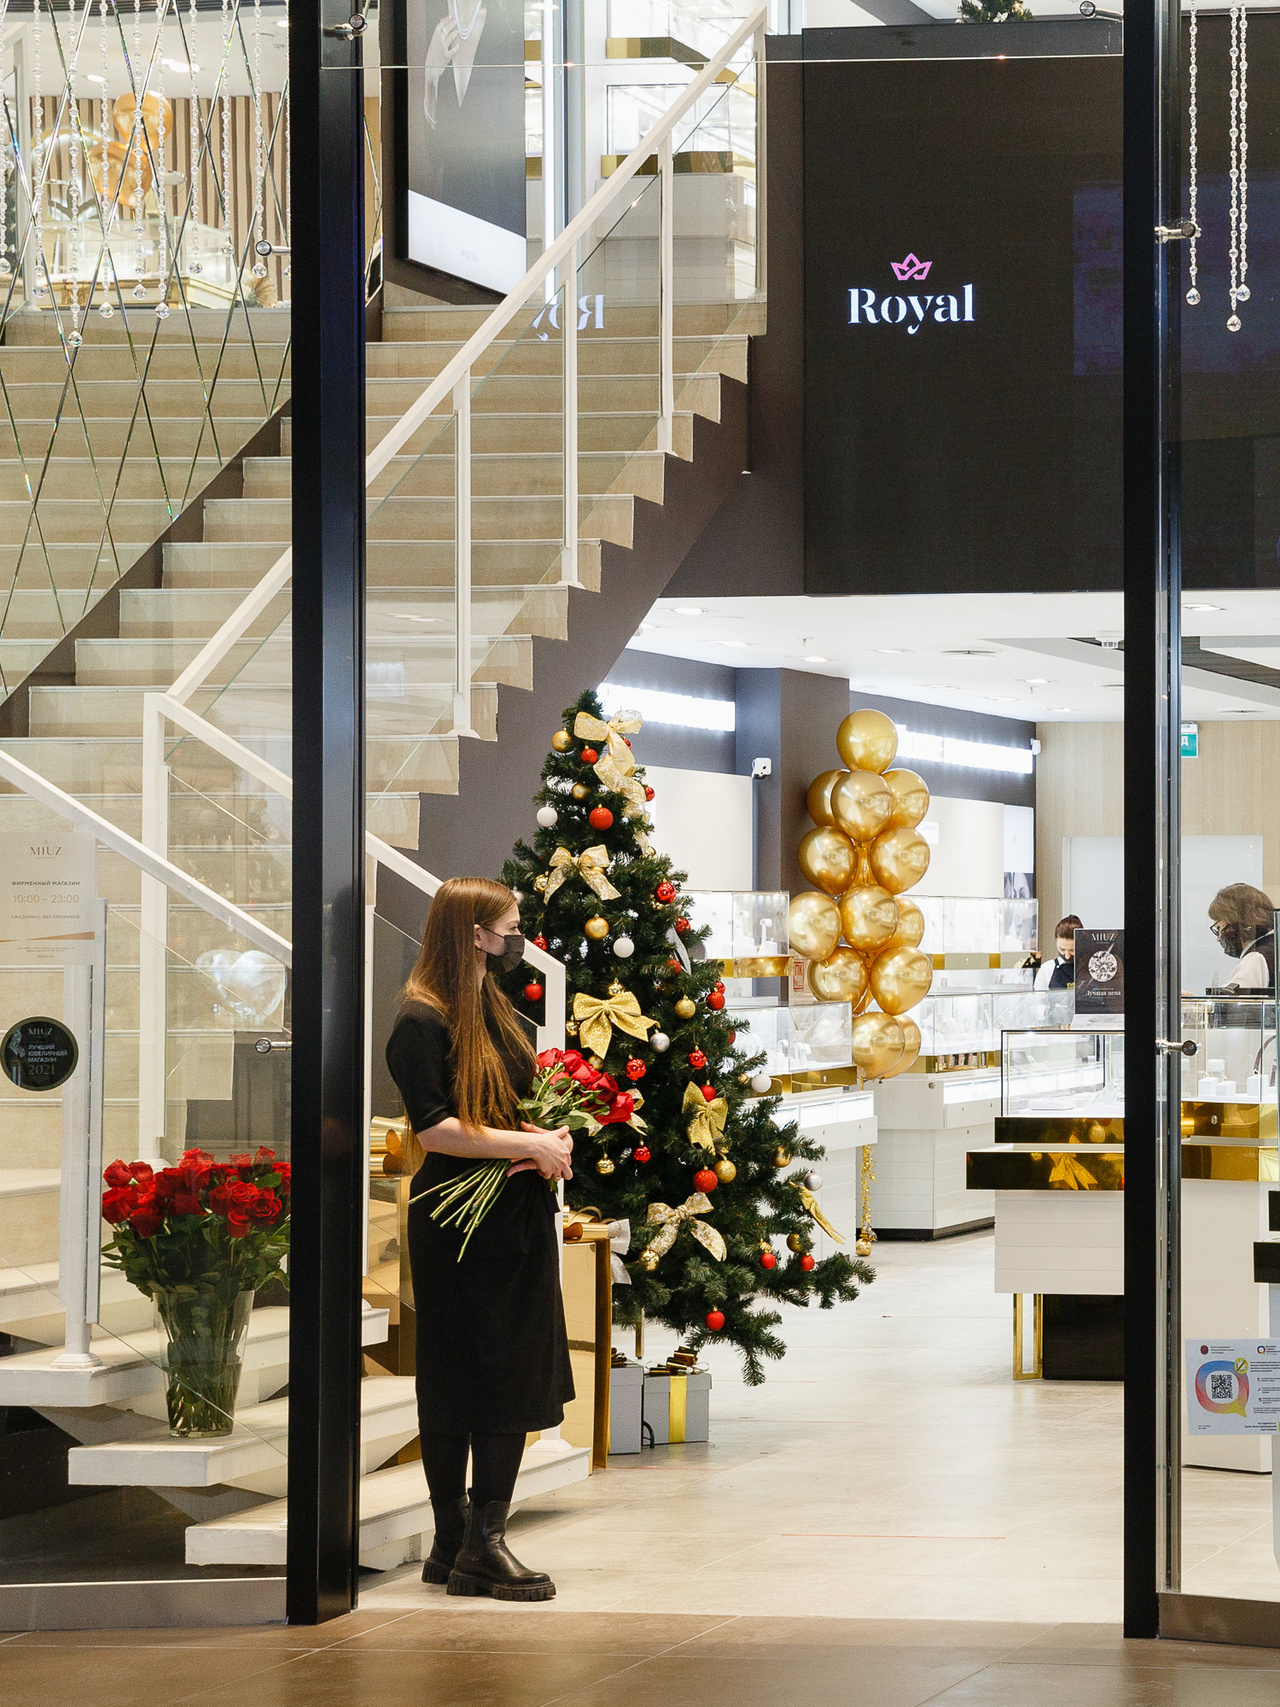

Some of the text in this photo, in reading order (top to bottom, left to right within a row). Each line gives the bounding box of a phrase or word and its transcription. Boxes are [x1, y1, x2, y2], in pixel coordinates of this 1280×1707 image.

[847, 283, 975, 335] Royal
[30, 846, 63, 855] MIUZ
[12, 894, 40, 904] 10:00
[51, 894, 80, 904] 23:00
[1091, 933, 1115, 941] MIUZ
[28, 1027, 53, 1036] MIUZ
[28, 1064, 55, 1075] 2021
